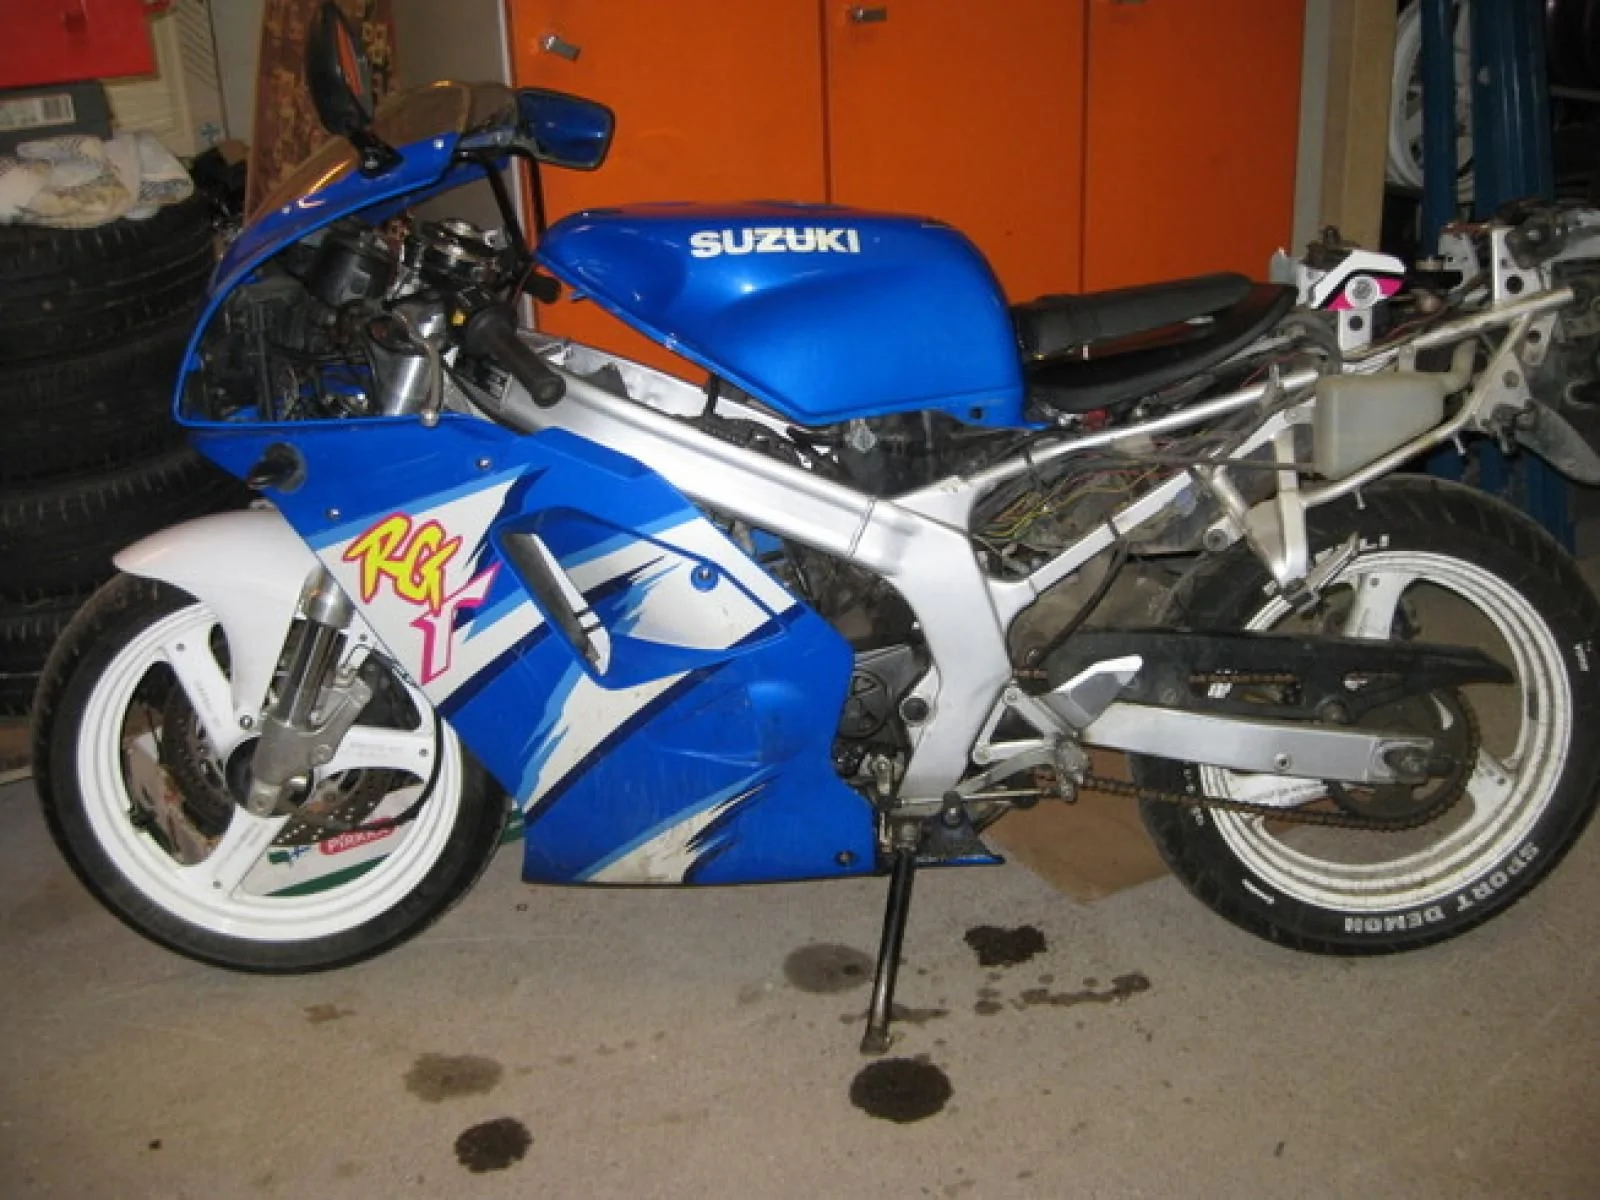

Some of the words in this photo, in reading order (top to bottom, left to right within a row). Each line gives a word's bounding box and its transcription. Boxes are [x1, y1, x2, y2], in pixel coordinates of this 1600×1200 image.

[690, 227, 860, 258] SUZUKI
[1456, 841, 1540, 912] SPORT
[1344, 905, 1447, 934] DEMON
